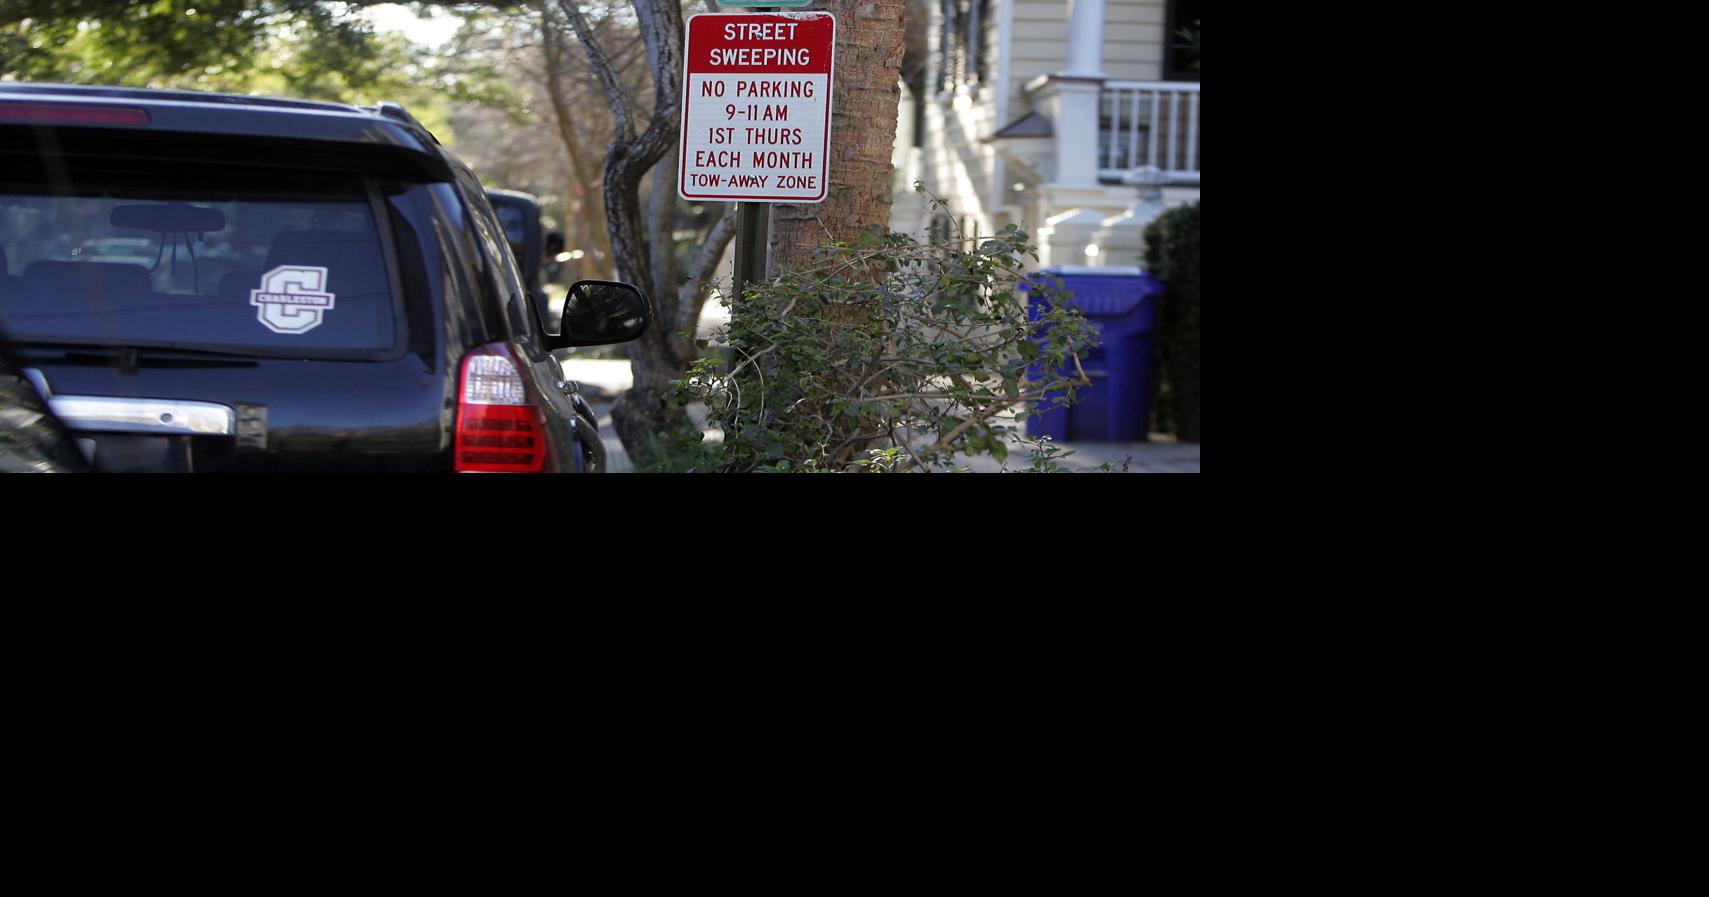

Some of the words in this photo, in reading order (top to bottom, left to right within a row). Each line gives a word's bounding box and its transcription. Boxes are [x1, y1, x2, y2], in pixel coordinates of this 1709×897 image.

[724, 23, 798, 41] STREET
[709, 48, 810, 66] SWEEPING
[702, 80, 725, 97] NO
[737, 81, 814, 98] PARKING
[709, 128, 735, 144] 1ST
[745, 128, 802, 145] THURS
[696, 151, 741, 168] EACH
[753, 152, 813, 169] MONTH
[691, 174, 768, 188] TOW-AWAY
[777, 176, 816, 189] ZONE
[257, 293, 328, 305] CHARLESTON
